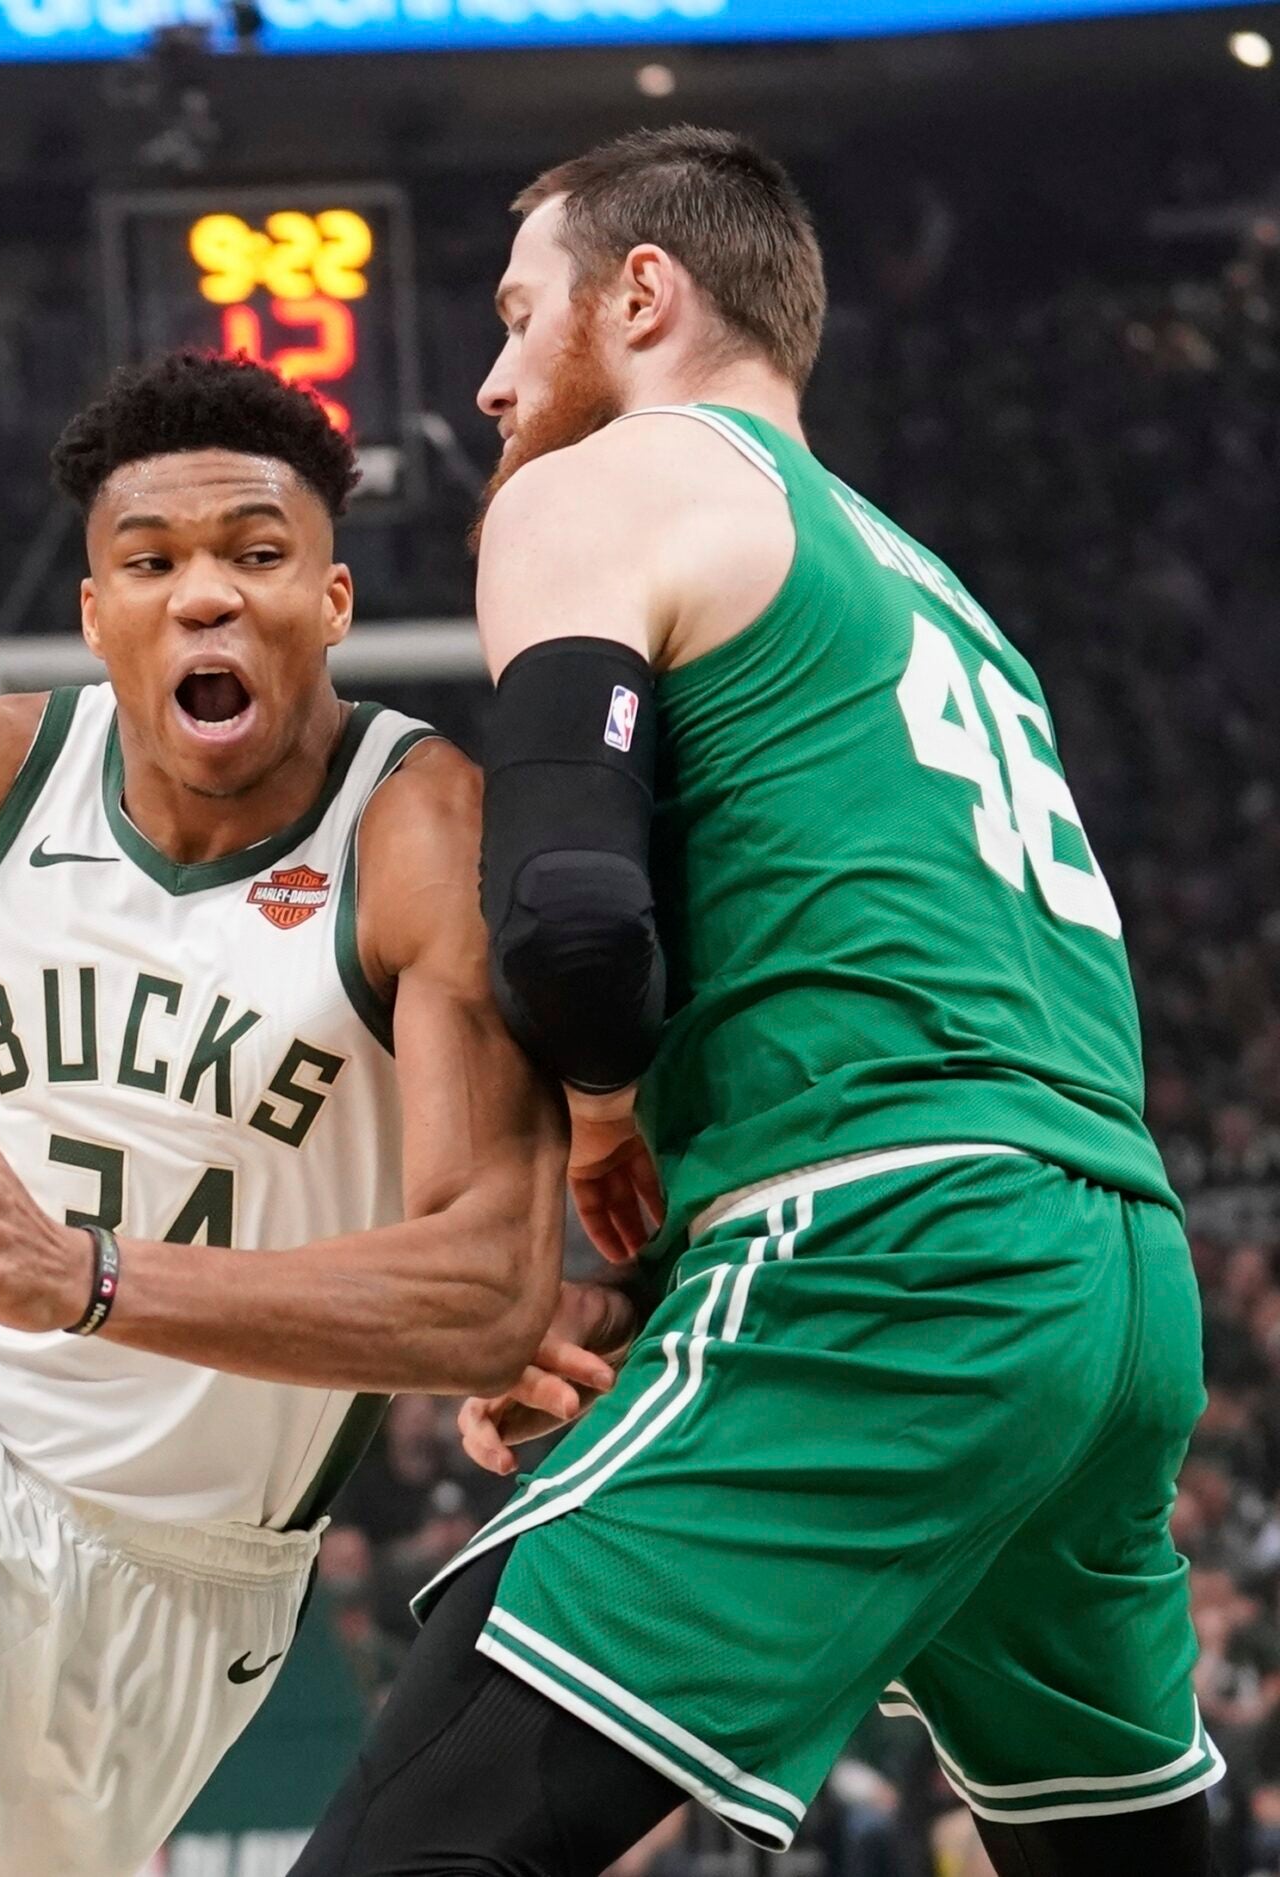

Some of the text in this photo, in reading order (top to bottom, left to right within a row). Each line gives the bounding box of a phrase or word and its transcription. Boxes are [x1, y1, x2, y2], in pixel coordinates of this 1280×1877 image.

[189, 209, 372, 304] 9:22
[896, 611, 1123, 940] 46
[266, 904, 309, 925] CYCLES
